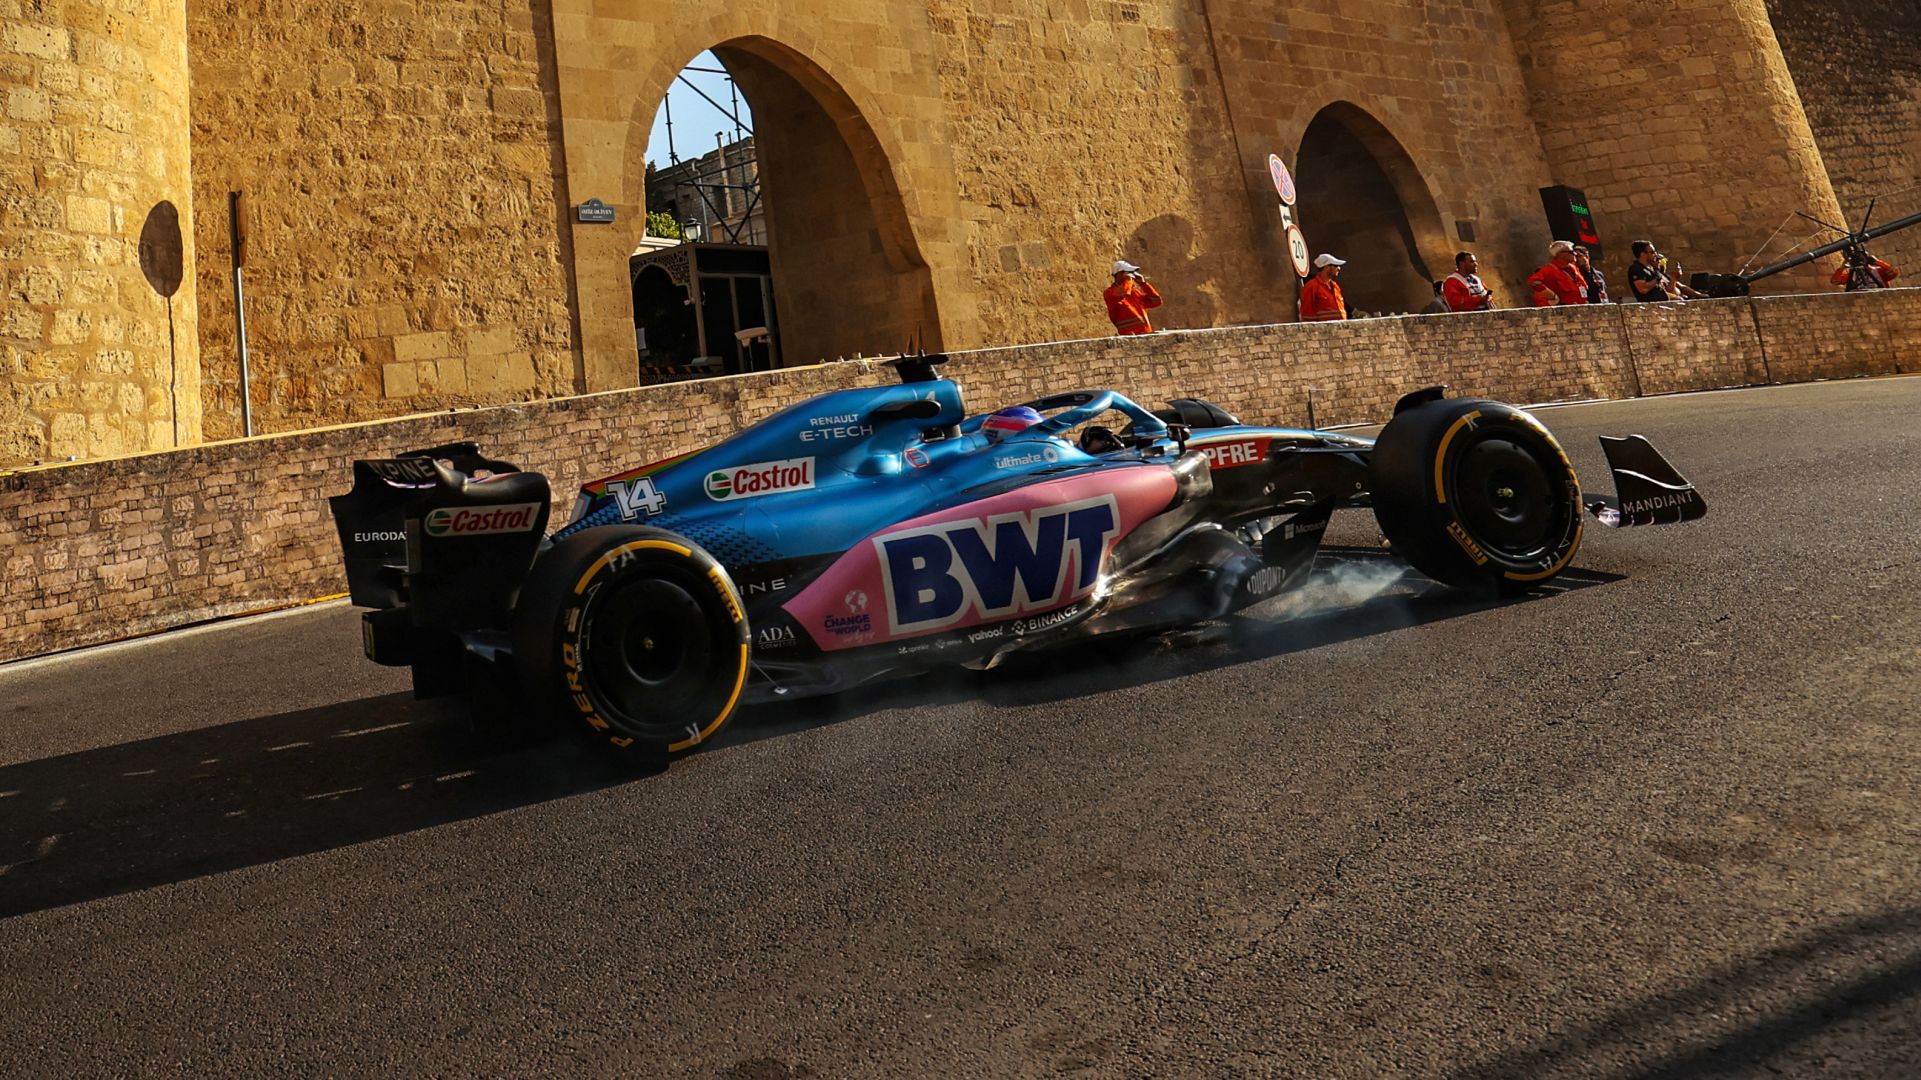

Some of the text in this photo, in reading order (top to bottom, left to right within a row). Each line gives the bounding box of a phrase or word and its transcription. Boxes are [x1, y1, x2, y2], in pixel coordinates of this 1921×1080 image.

[1292, 240, 1304, 259] 20
[810, 414, 859, 426] RENAULT
[996, 453, 1041, 468] ultimate
[1202, 442, 1259, 467] PFRE
[734, 461, 811, 495] Castrol
[605, 476, 667, 521] 14
[1623, 491, 1693, 514] MANDIANT
[452, 507, 533, 532] Castrol
[354, 531, 407, 542] EURODA
[880, 500, 1117, 630] BWT
[740, 578, 786, 596] INE
[824, 614, 870, 628] CHANGE
[1028, 604, 1079, 630] BINANCE
[759, 625, 796, 642] ADA
[968, 625, 1004, 643] yahoo!
[562, 642, 609, 732] ZERO
